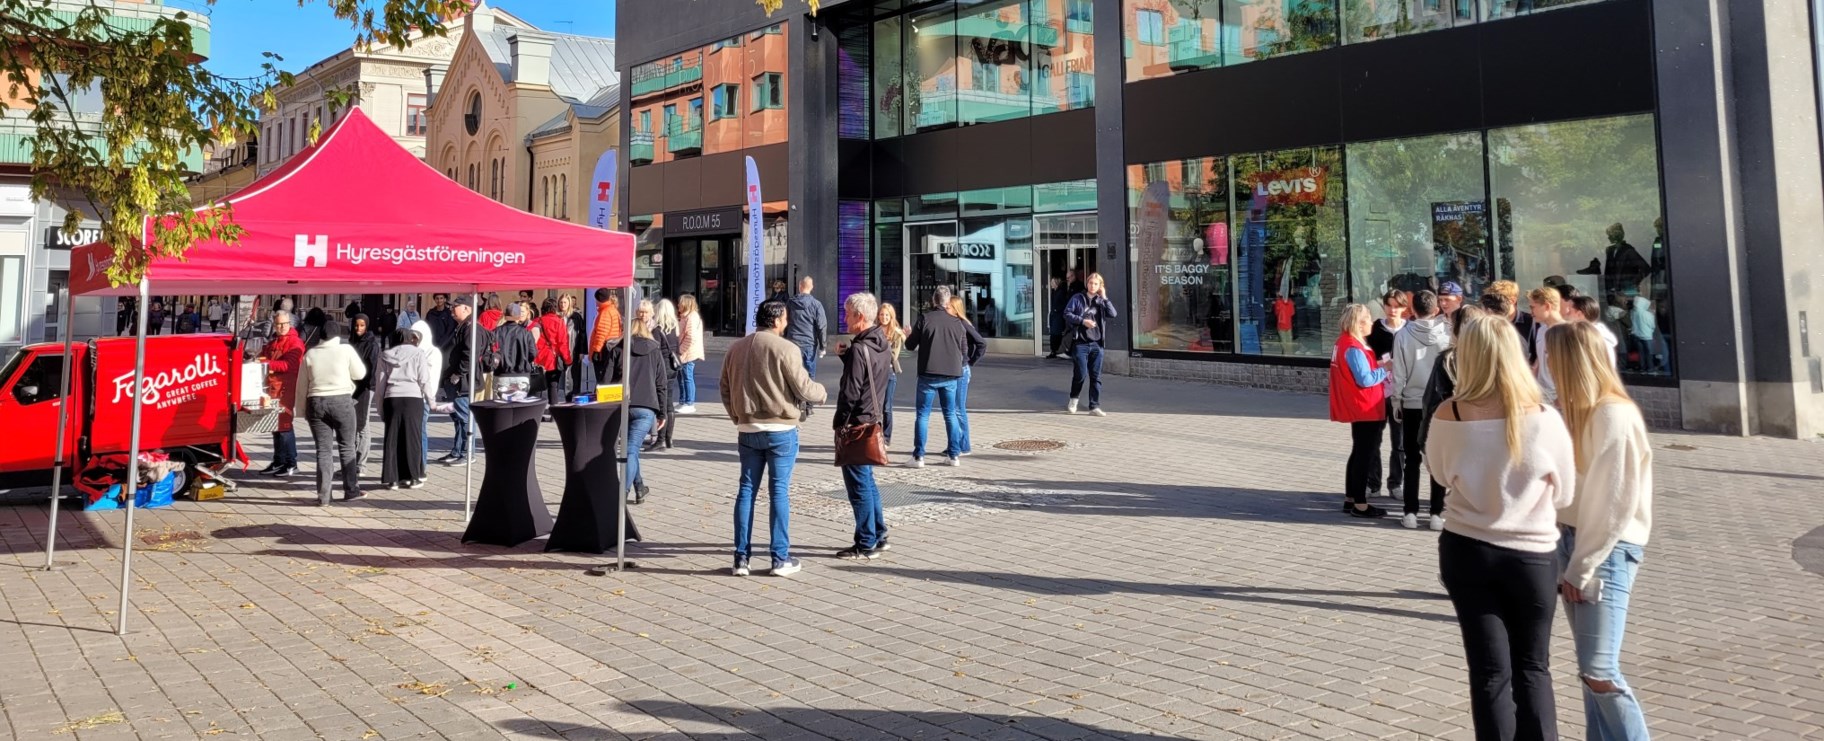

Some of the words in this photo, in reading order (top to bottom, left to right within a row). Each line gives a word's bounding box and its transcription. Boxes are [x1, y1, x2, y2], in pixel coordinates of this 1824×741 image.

[1041, 56, 1093, 79] GALLERIAN
[1435, 205, 1452, 213] ALLA
[711, 213, 721, 228] 55
[336, 242, 526, 267] Hyresgästföreningen
[1154, 264, 1172, 274] IT'S
[1174, 263, 1210, 273] BAGGY
[1161, 275, 1203, 285] SEASON
[165, 386, 190, 399] GREAT
[191, 378, 219, 392] COFFEE
[156, 393, 198, 410] ANYWHERE
